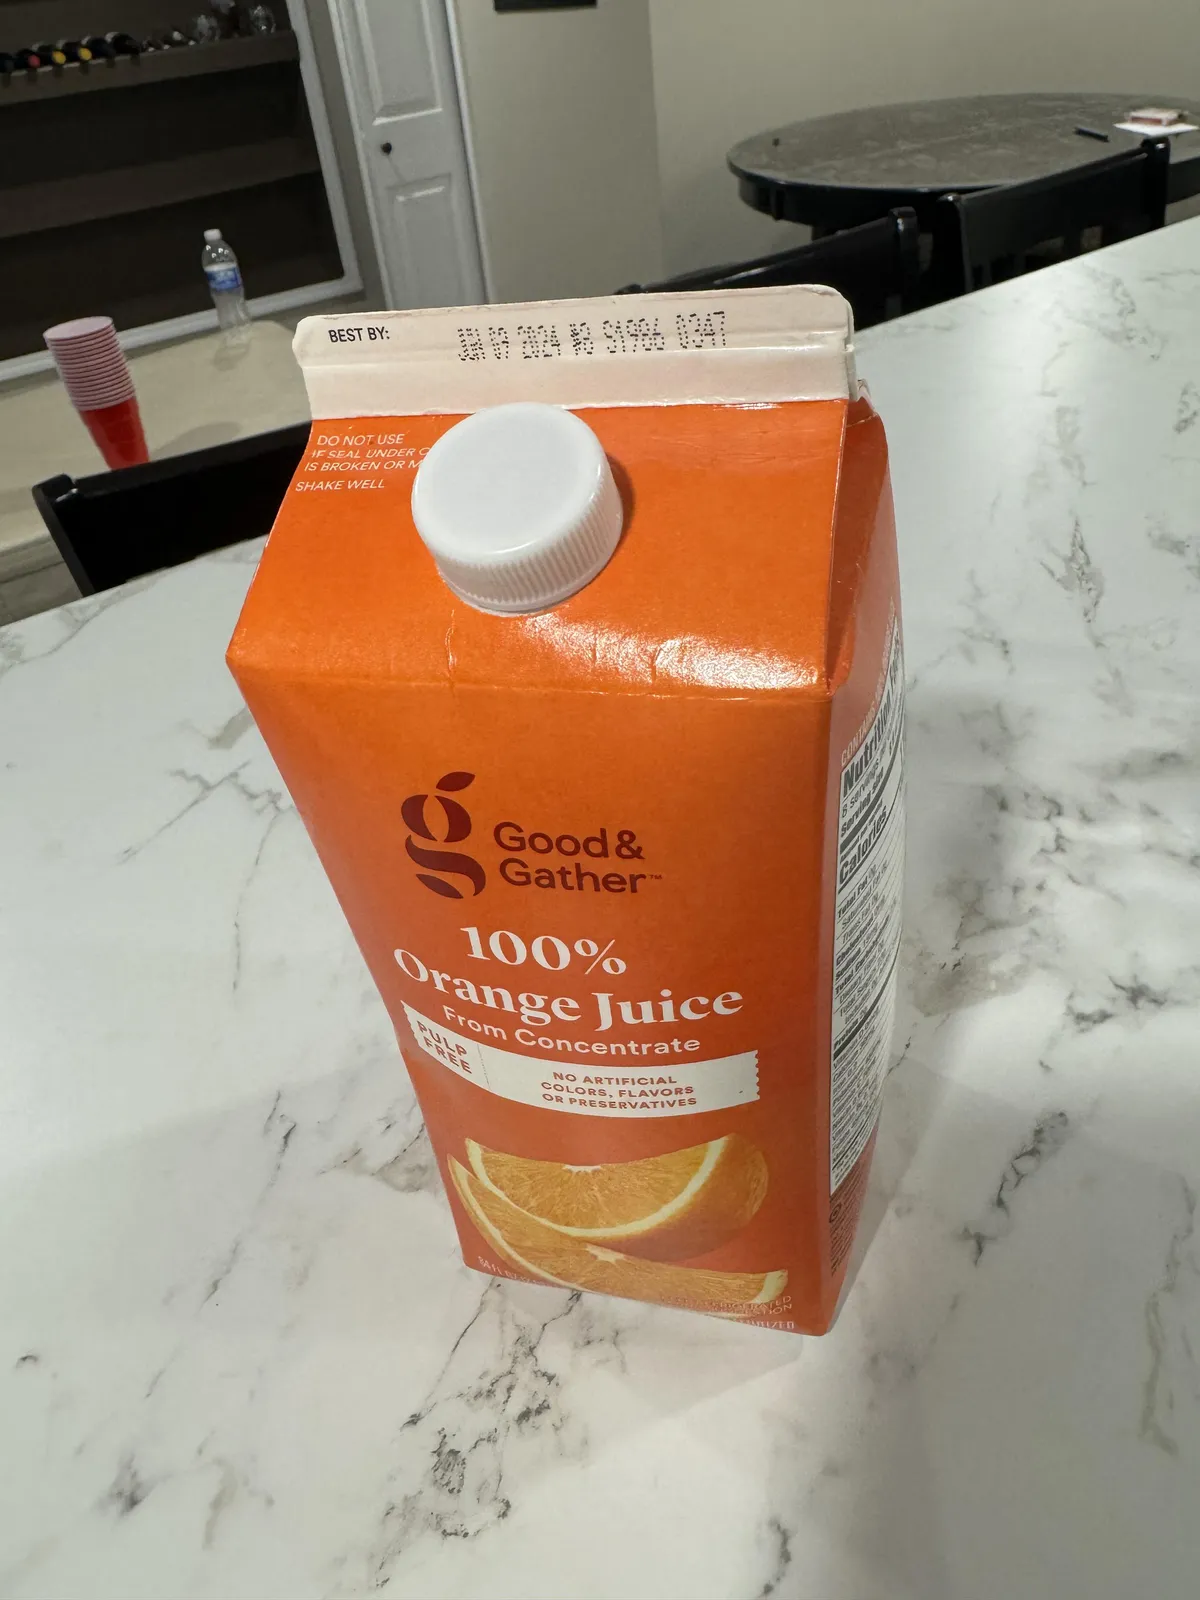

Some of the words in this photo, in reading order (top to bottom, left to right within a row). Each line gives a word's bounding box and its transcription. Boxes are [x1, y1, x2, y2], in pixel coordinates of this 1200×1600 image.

[328, 328, 363, 343] BEST
[367, 326, 390, 341] BY:
[517, 325, 561, 360] 2024
[676, 310, 726, 349] 0347
[317, 435, 339, 446] DO
[342, 434, 375, 446] NOT
[377, 434, 405, 445] USE
[327, 450, 361, 459] SEAL
[365, 448, 415, 458] UNDER
[304, 462, 318, 472] IS
[320, 461, 380, 472] BROKEN
[383, 460, 405, 470] OR
[295, 480, 344, 492] SHAKE
[347, 479, 385, 490] WELL
[843, 690, 890, 798] Nutrition
[840, 790, 872, 837] Serving
[840, 805, 887, 884] Calories
[460, 926, 627, 976] 100%
[393, 948, 581, 1026] Orange
[591, 988, 744, 1032] Juice
[417, 1020, 467, 1056] PULP
[444, 1005, 508, 1041] From
[514, 1028, 701, 1057] Concentrate
[423, 1036, 472, 1074] FREE
[541, 1081, 613, 1099] COLORS,
[618, 1086, 694, 1098] FLAVORS
[552, 1071, 577, 1082] NO
[582, 1075, 677, 1086] ARTIFICIAL
[542, 1093, 564, 1104] OR
[568, 1097, 697, 1110] PRESERVATIVES
